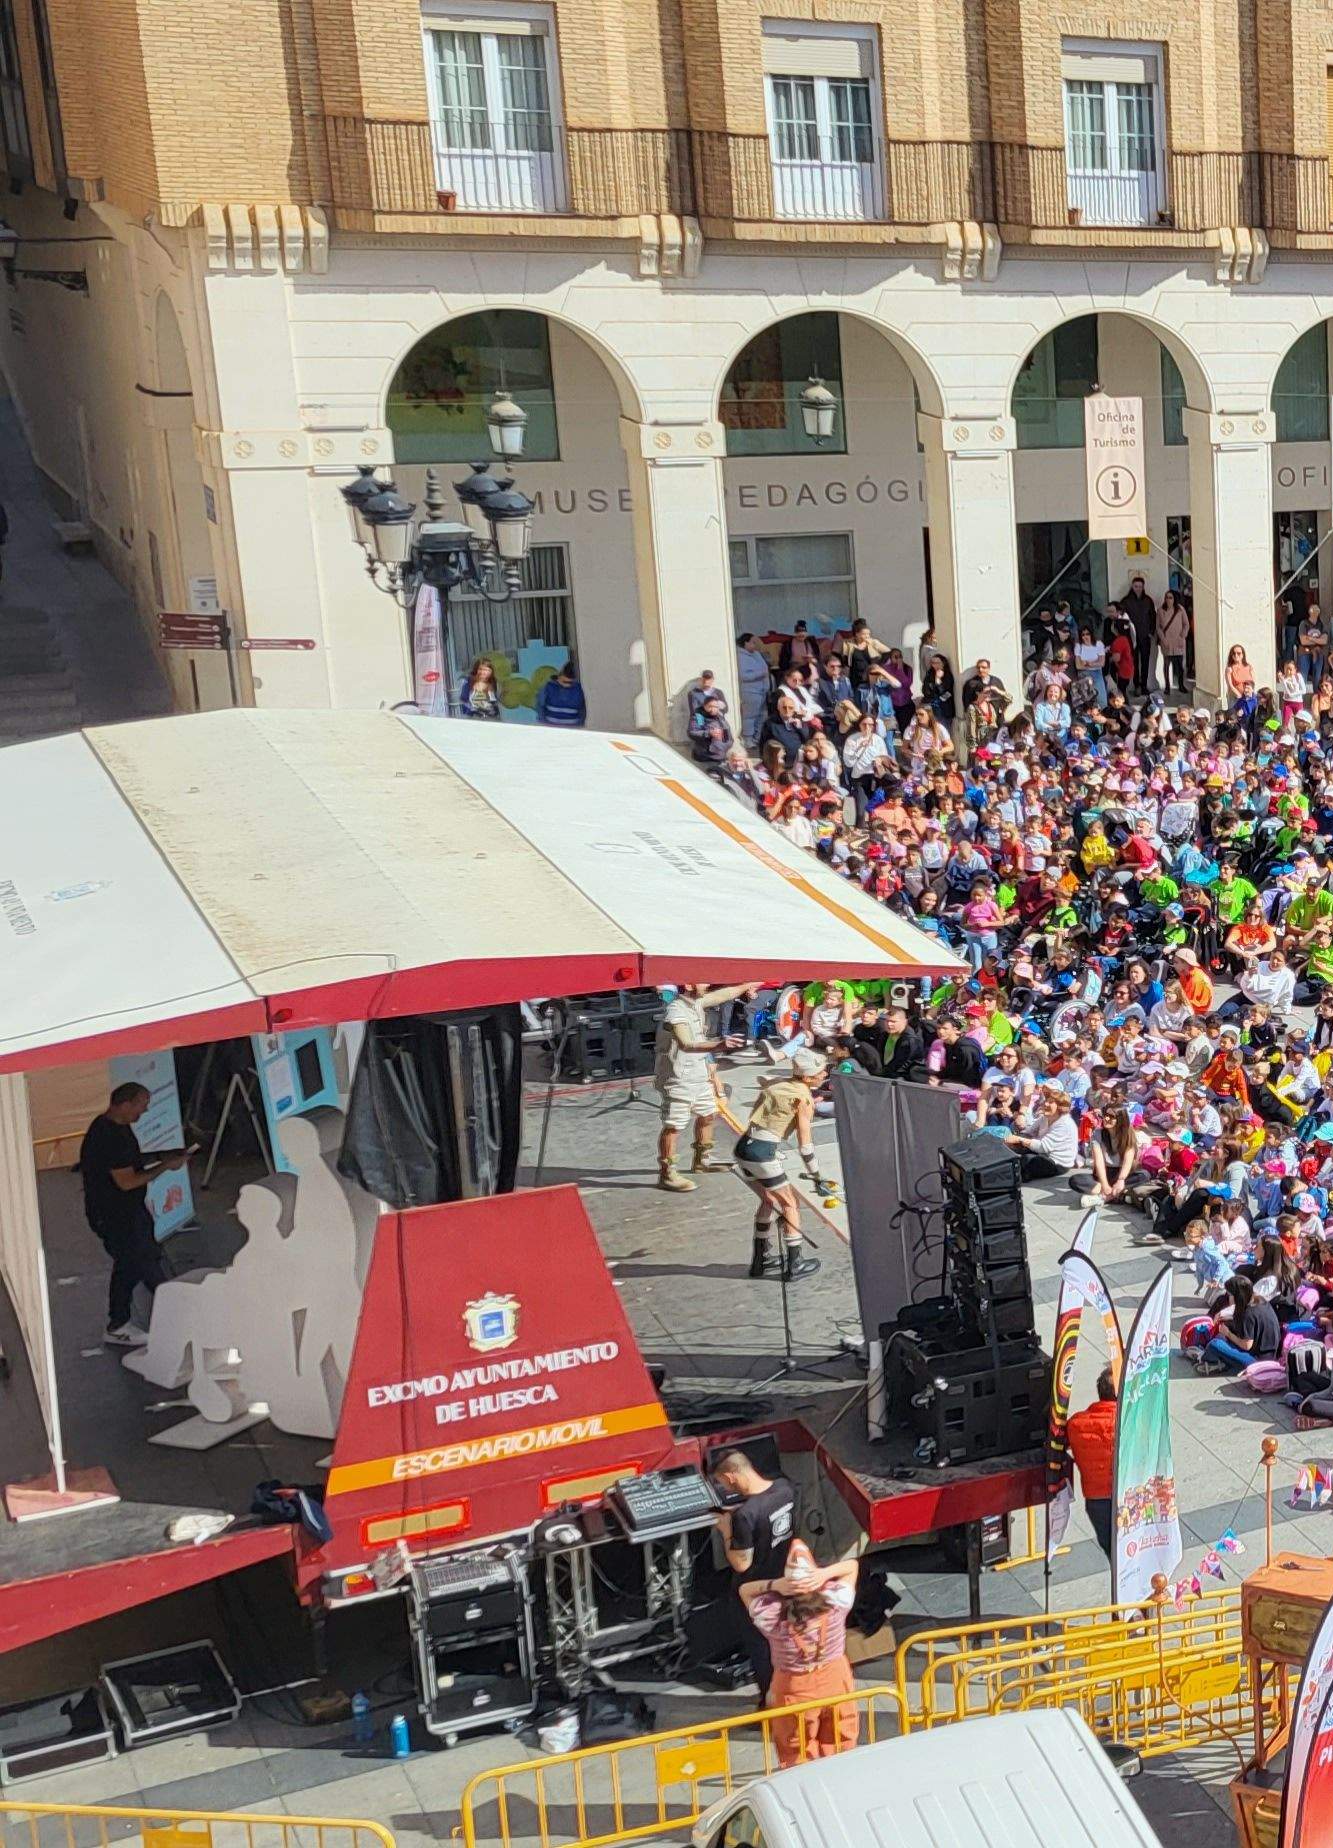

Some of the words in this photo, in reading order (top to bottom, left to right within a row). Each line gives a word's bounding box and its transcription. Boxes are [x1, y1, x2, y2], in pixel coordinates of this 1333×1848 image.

[1097, 411, 1135, 424] Oficina
[1121, 424, 1136, 436] de
[1093, 437, 1136, 449] Turismo
[725, 475, 924, 508] EDAGÓGI
[367, 1374, 449, 1409] EXCMO
[450, 1340, 619, 1392] AYUNTAMIENTO
[434, 1399, 468, 1425] DE
[468, 1383, 560, 1419] HUESCA
[391, 1434, 540, 1480] ESCENARIO
[534, 1416, 610, 1449] MOVIL
